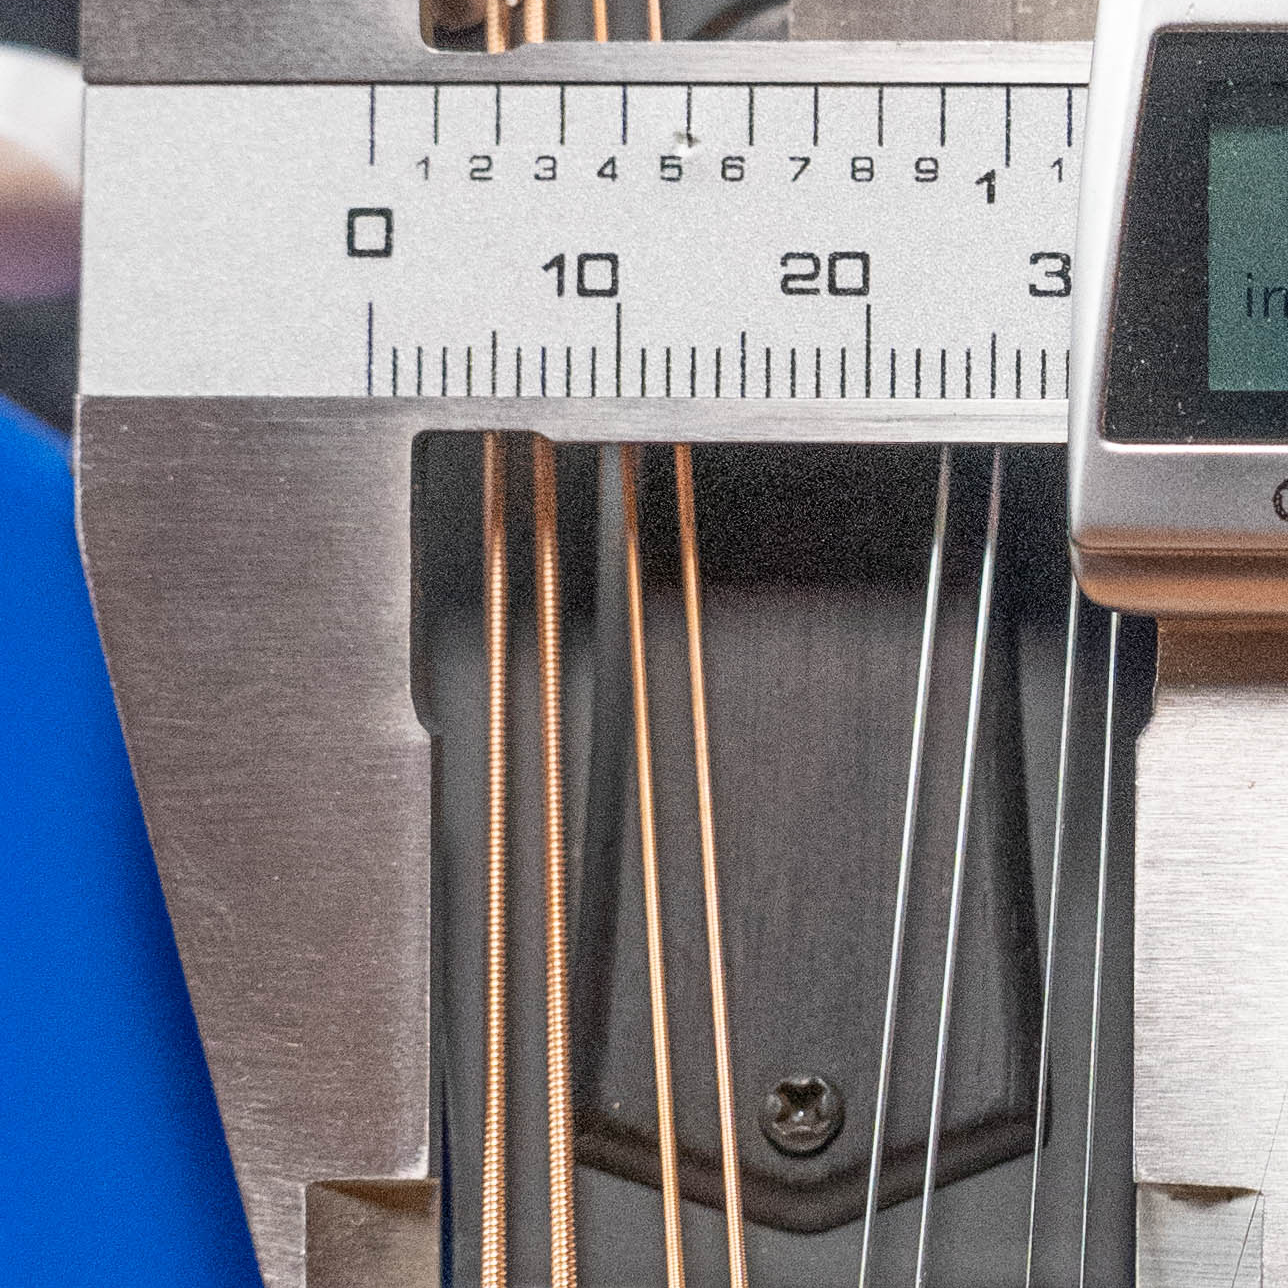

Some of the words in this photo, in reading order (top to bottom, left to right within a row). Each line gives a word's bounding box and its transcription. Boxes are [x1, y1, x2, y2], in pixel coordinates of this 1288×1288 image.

[416, 155, 432, 182] 1
[467, 154, 495, 183] 2
[532, 154, 559, 183] 3
[595, 155, 620, 183] 4
[658, 154, 685, 183] 5
[719, 155, 746, 183] 6
[788, 155, 813, 183] 7
[849, 155, 876, 183] 8
[912, 155, 941, 184] 9
[974, 169, 997, 205] 1
[1049, 156, 1066, 184] 1
[345, 206, 395, 260] 0
[541, 252, 621, 299] 10
[779, 251, 872, 297] 20
[1028, 251, 1073, 299] 3
